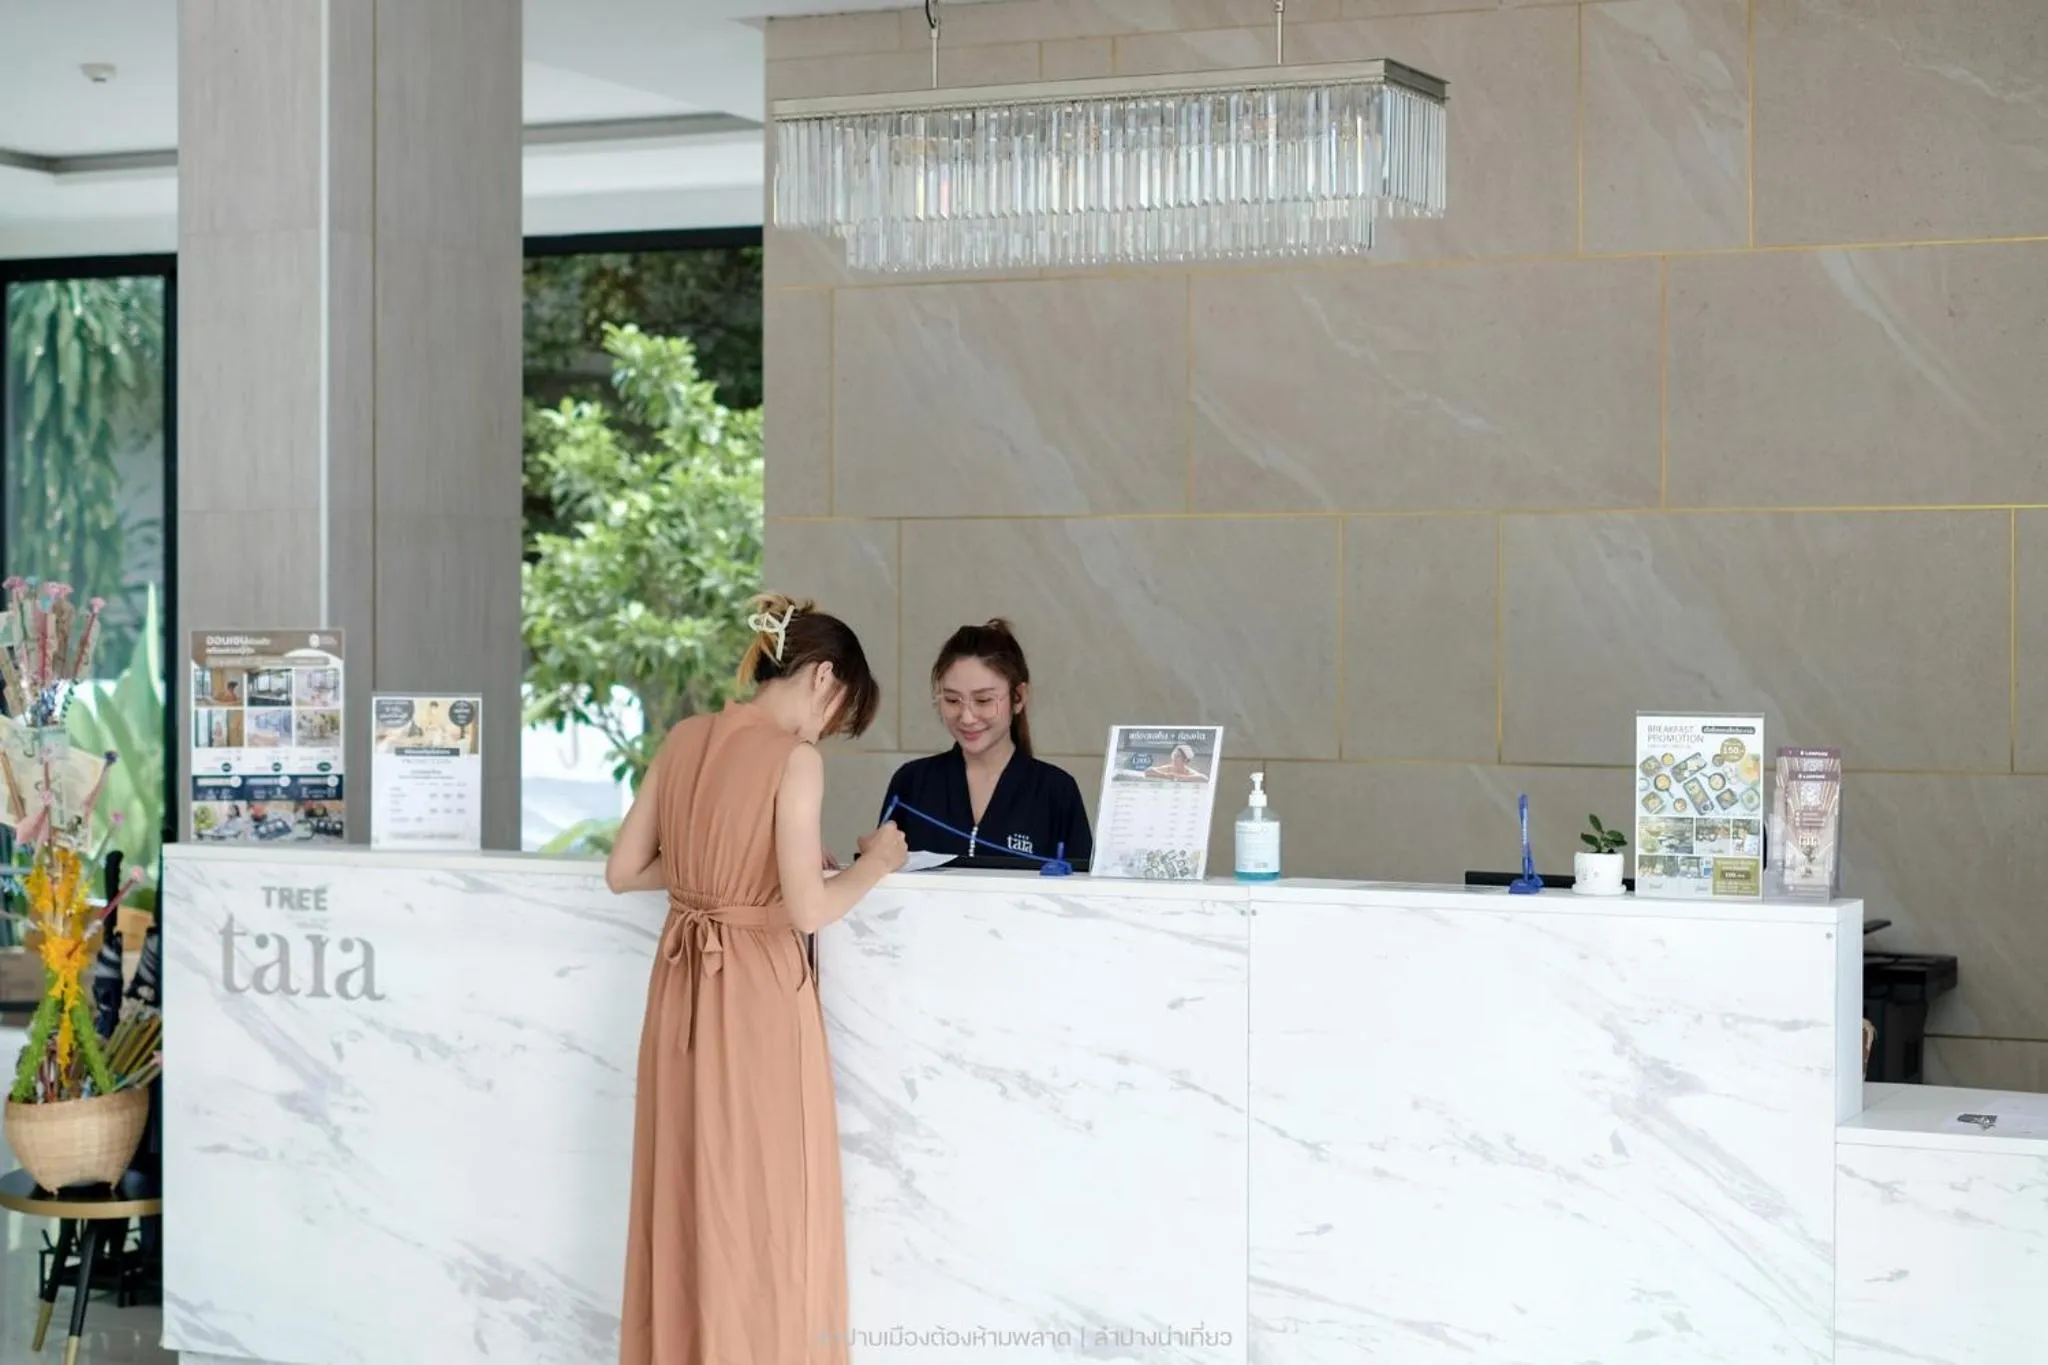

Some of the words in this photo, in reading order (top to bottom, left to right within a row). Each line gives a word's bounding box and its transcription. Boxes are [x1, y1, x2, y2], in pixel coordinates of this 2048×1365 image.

[1647, 725, 1695, 734] BREAKFAST
[1647, 734, 1704, 744] PROMOTION
[260, 886, 329, 911] TREE
